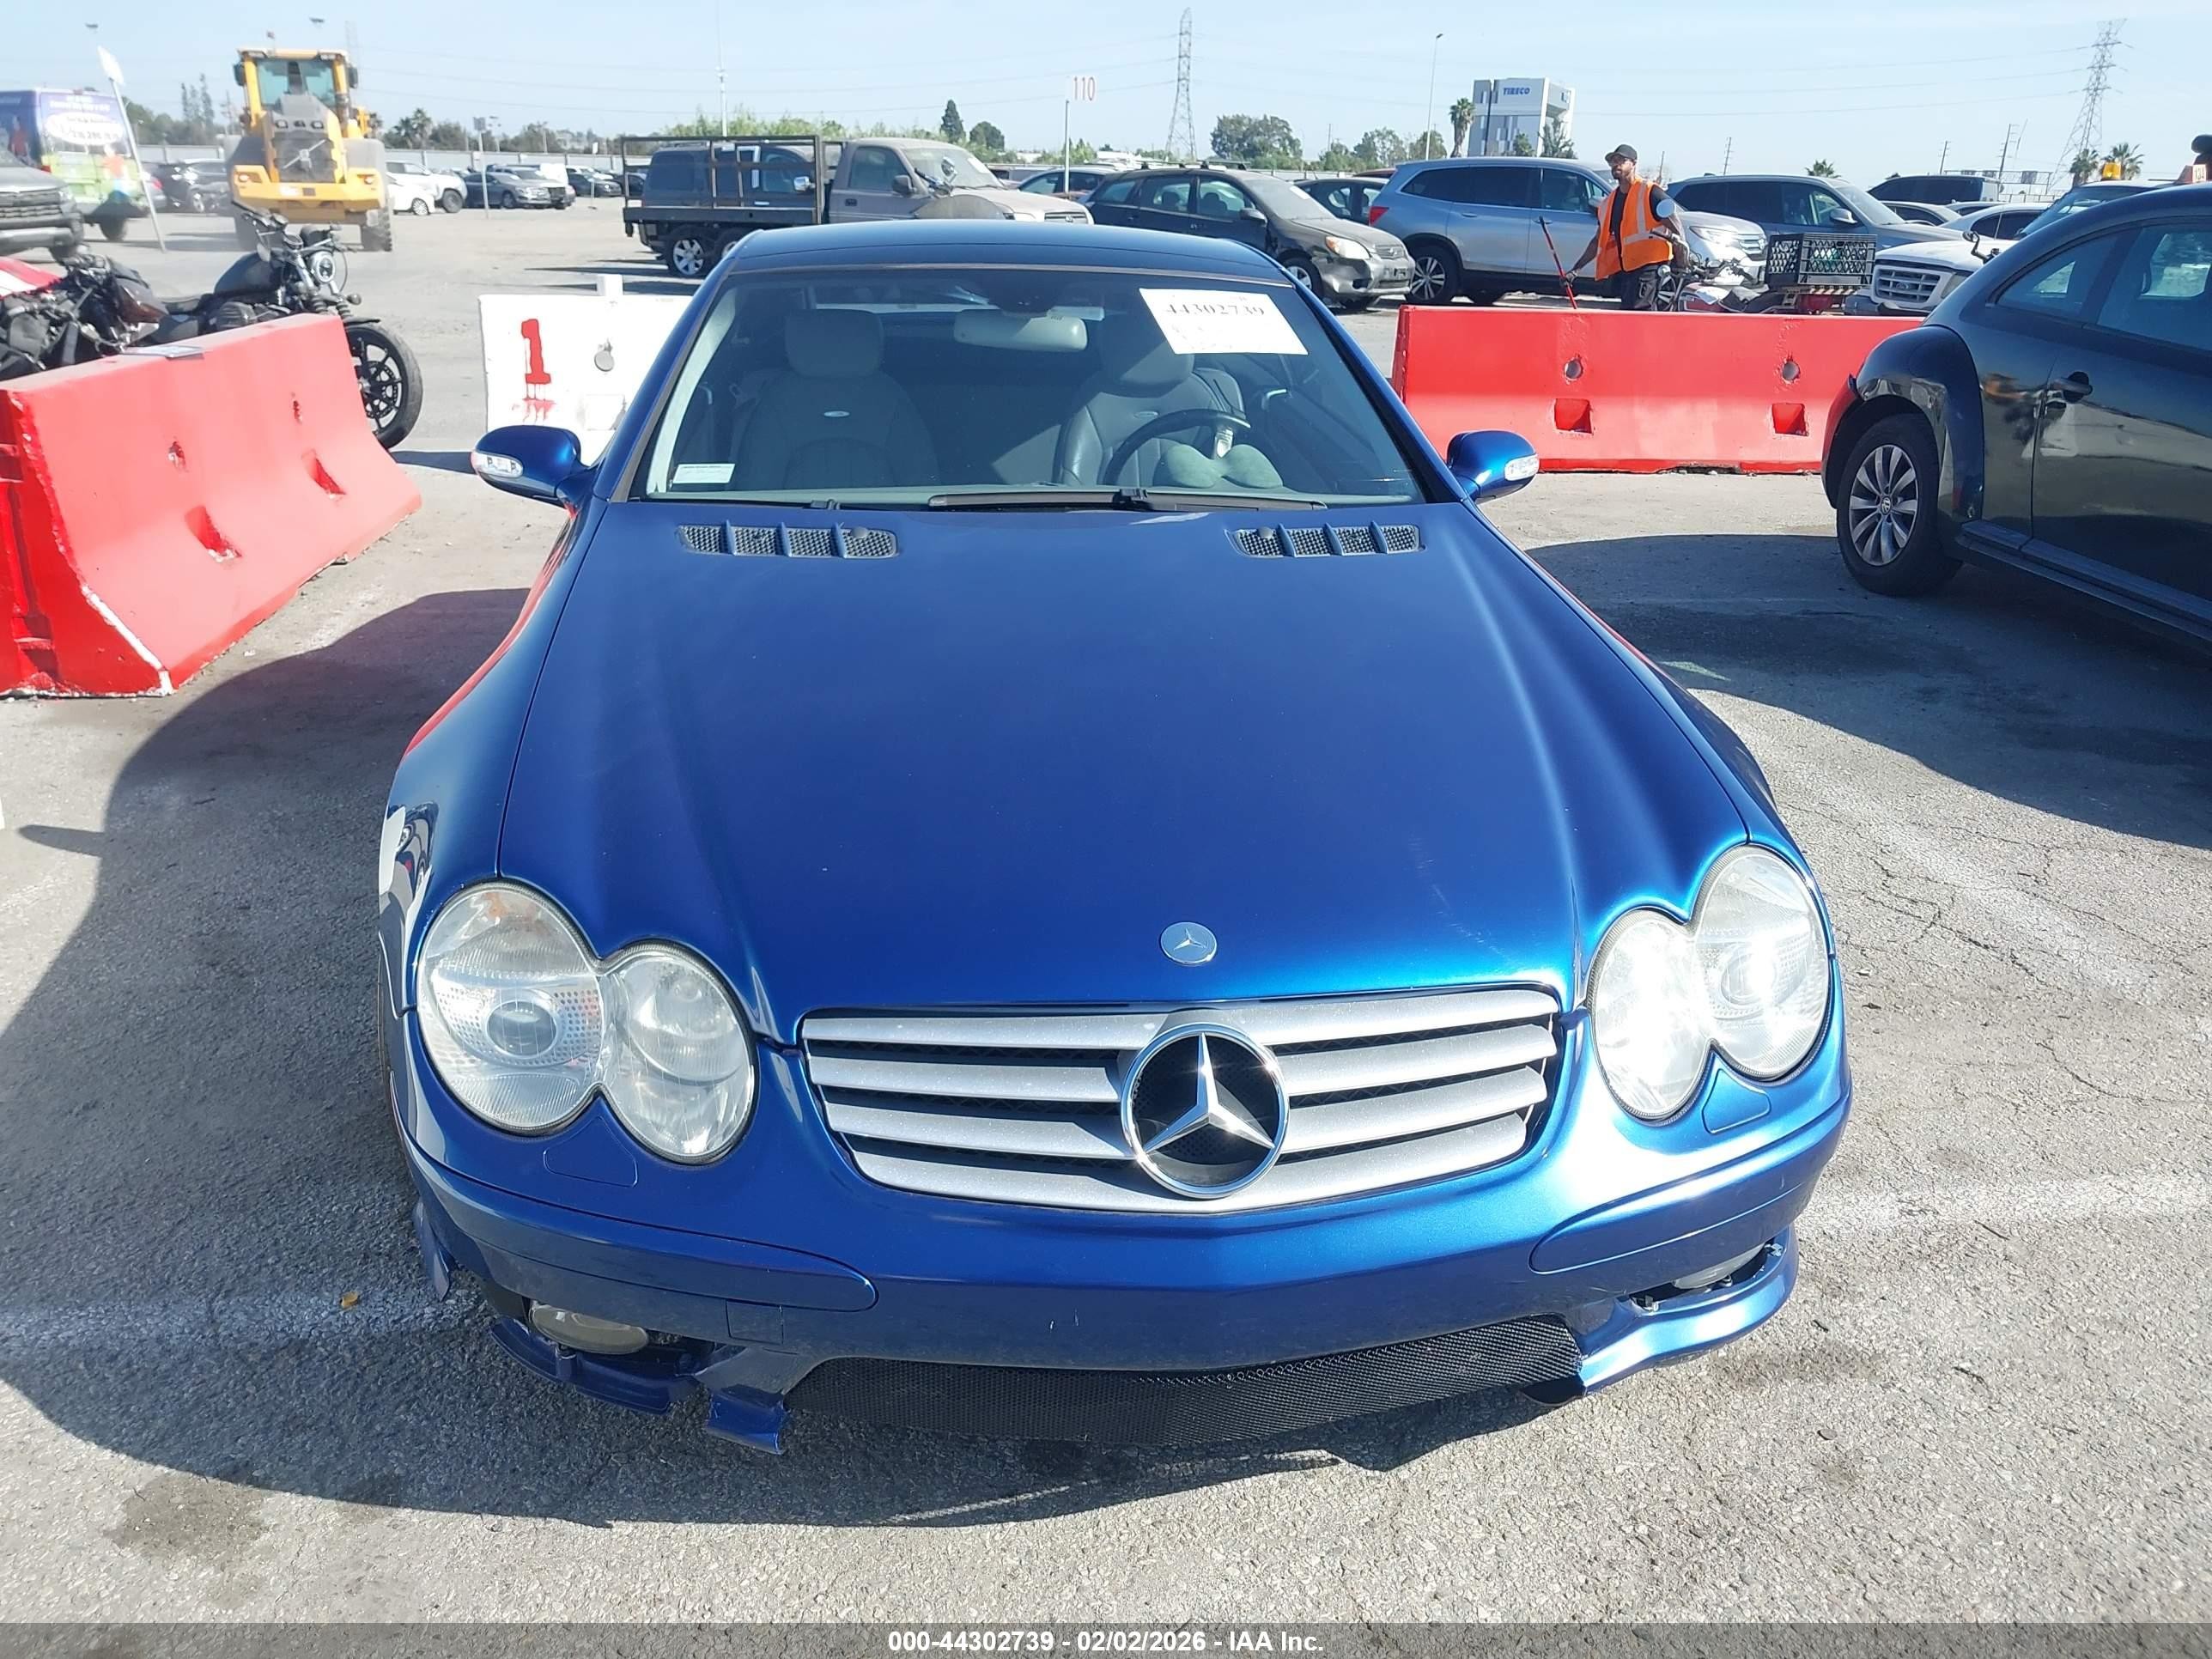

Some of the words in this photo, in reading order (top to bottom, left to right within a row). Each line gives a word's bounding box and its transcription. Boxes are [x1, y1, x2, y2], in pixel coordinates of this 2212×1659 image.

[1073, 76, 1096, 101] 110
[1503, 87, 1531, 95] TIRECO
[1164, 303, 1265, 316] 44302739
[520, 318, 552, 385] 1
